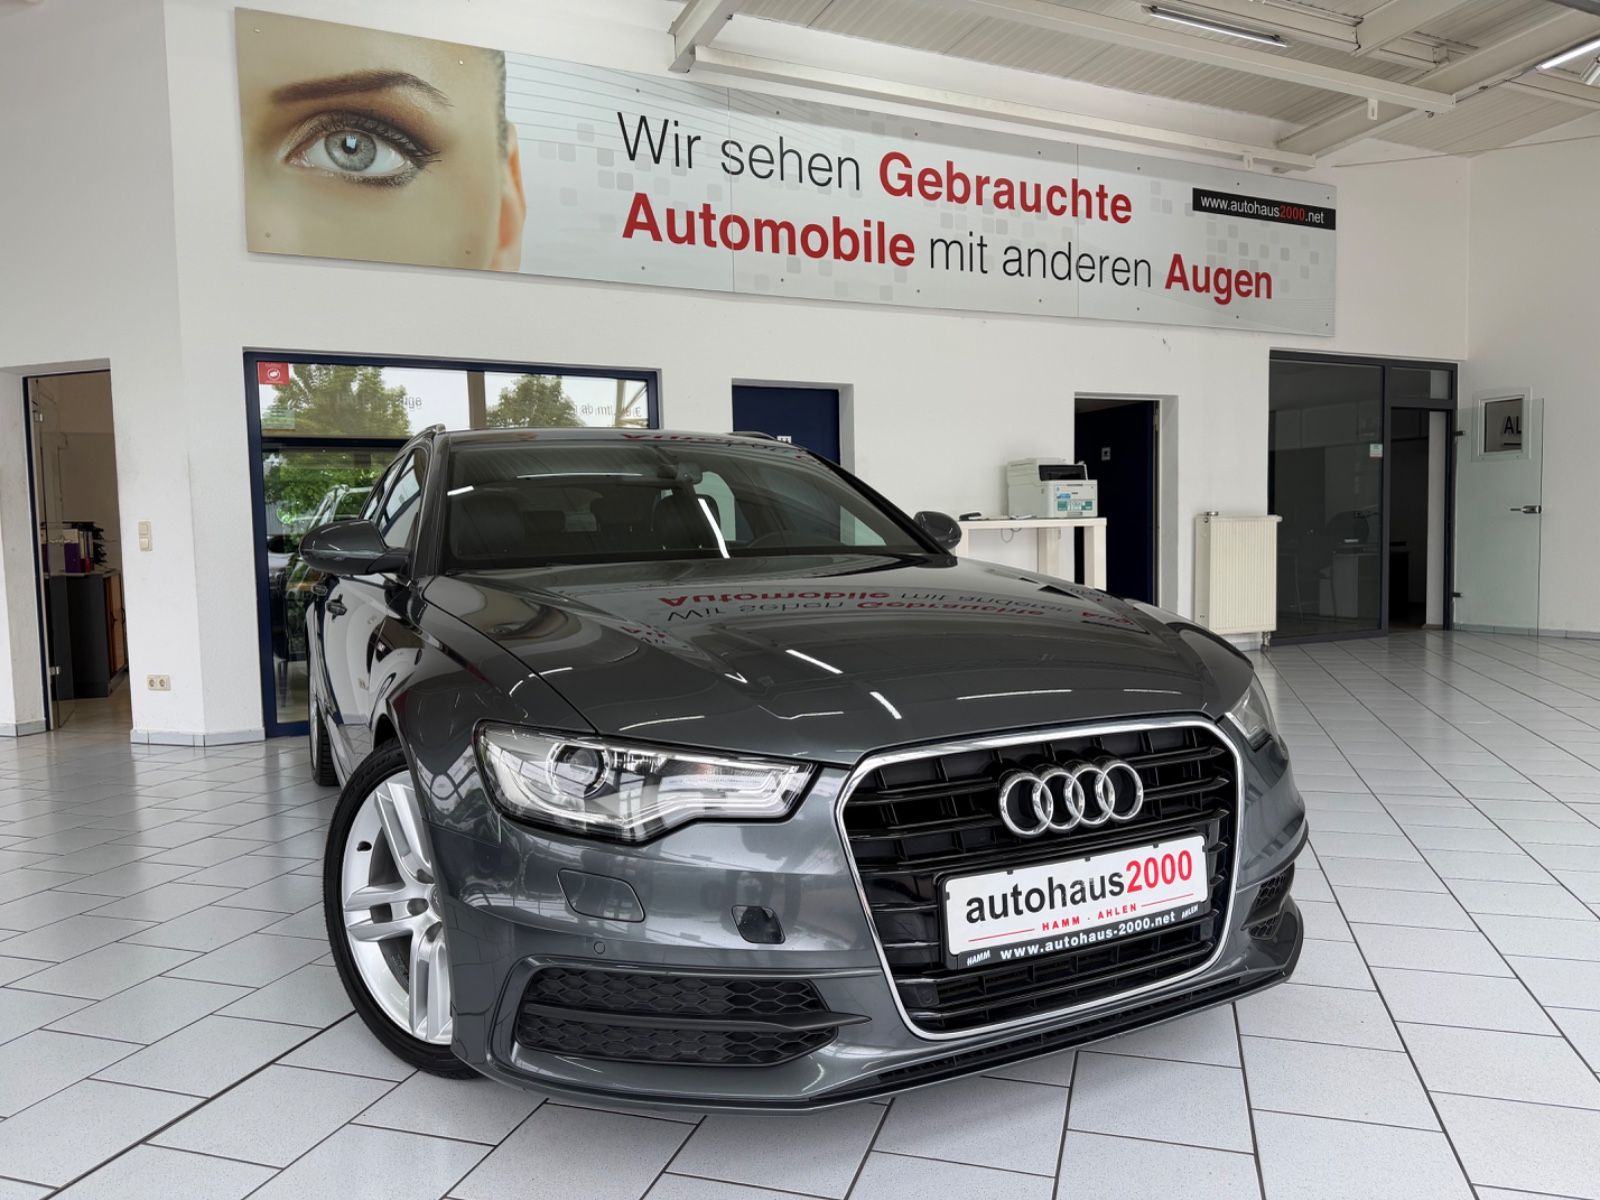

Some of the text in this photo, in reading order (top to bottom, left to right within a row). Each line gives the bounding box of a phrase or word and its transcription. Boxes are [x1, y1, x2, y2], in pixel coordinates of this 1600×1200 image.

[617, 111, 1132, 224] Wir sehen Gebrauchte
[1200, 195, 1324, 224] www.autohaus2000.net
[622, 192, 1273, 305] Automobile mit anderen Augen
[965, 849, 1193, 924] autohaus2000
[1042, 903, 1137, 932] HAMM AHLEN
[966, 904, 1199, 967] HAMM www.autohaus-2000.net AHLEN
